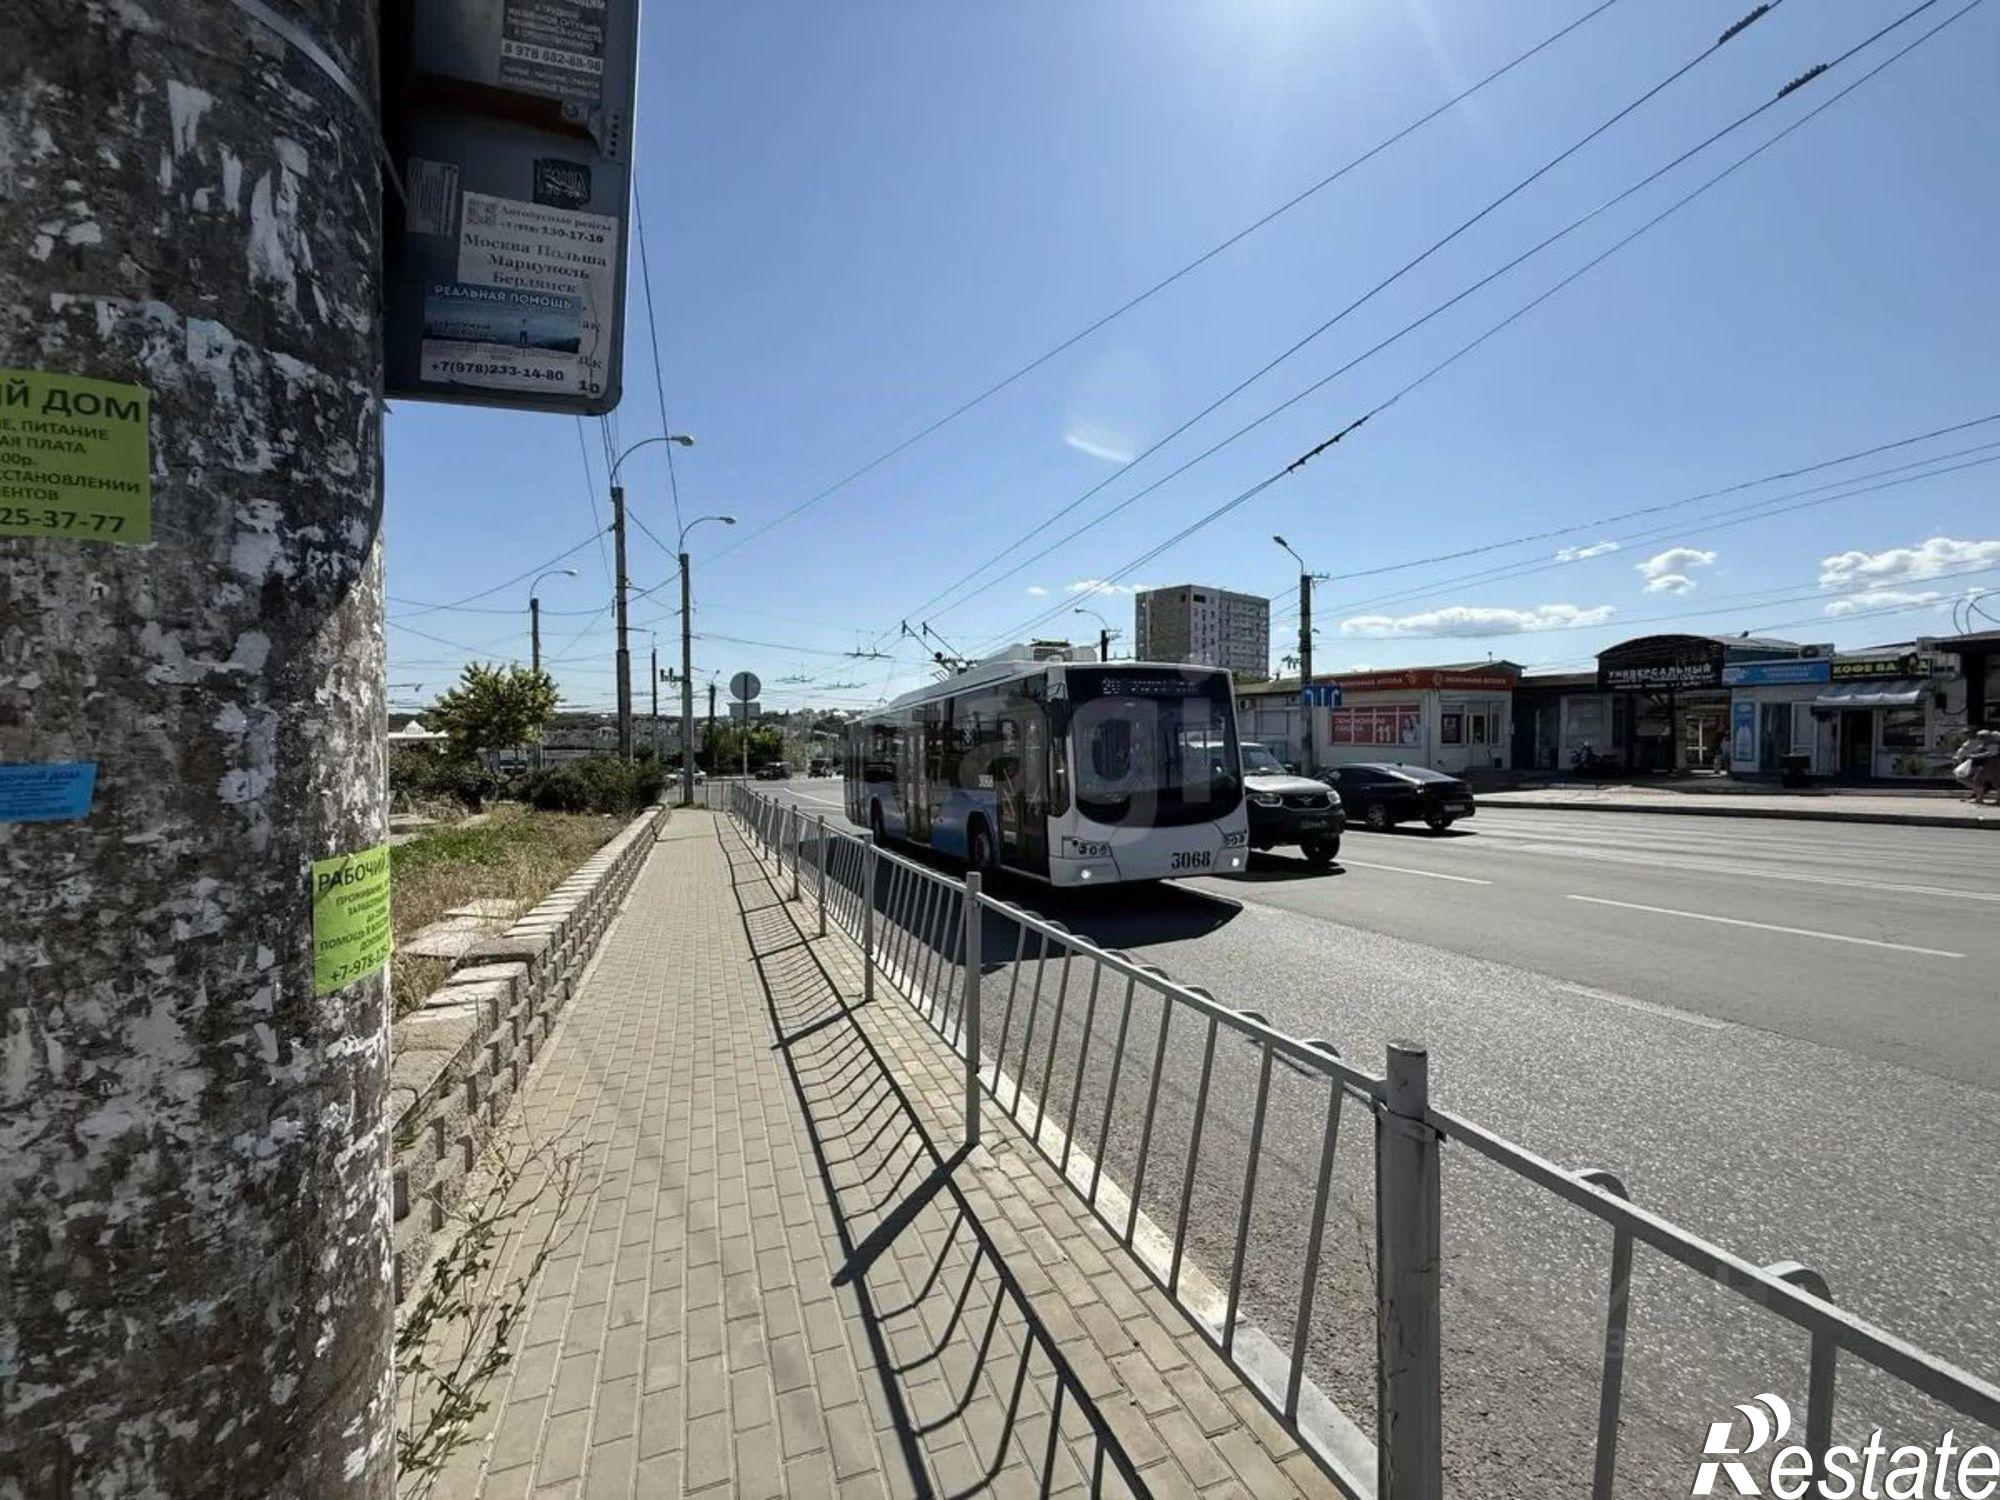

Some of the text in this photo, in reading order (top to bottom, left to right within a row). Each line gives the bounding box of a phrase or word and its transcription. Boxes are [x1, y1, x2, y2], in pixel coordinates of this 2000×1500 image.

[463, 232, 607, 267] Москва Польша
[487, 253, 590, 281] Мариуполь
[434, 284, 573, 310] РЕАЛЬНАЯ ПОМОЩЬ
[0, 378, 141, 423] Й ДОМ
[22, 420, 109, 441] ПИТАНИЕ
[26, 437, 88, 454] ПЛАТА
[0, 469, 141, 494] СТАНОВЛЕНИИ
[1608, 662, 1713, 681] УНИВЕРСАЛЬНЫЙ
[1832, 663, 1873, 675] КОФЕ
[1170, 851, 1212, 870] 3068
